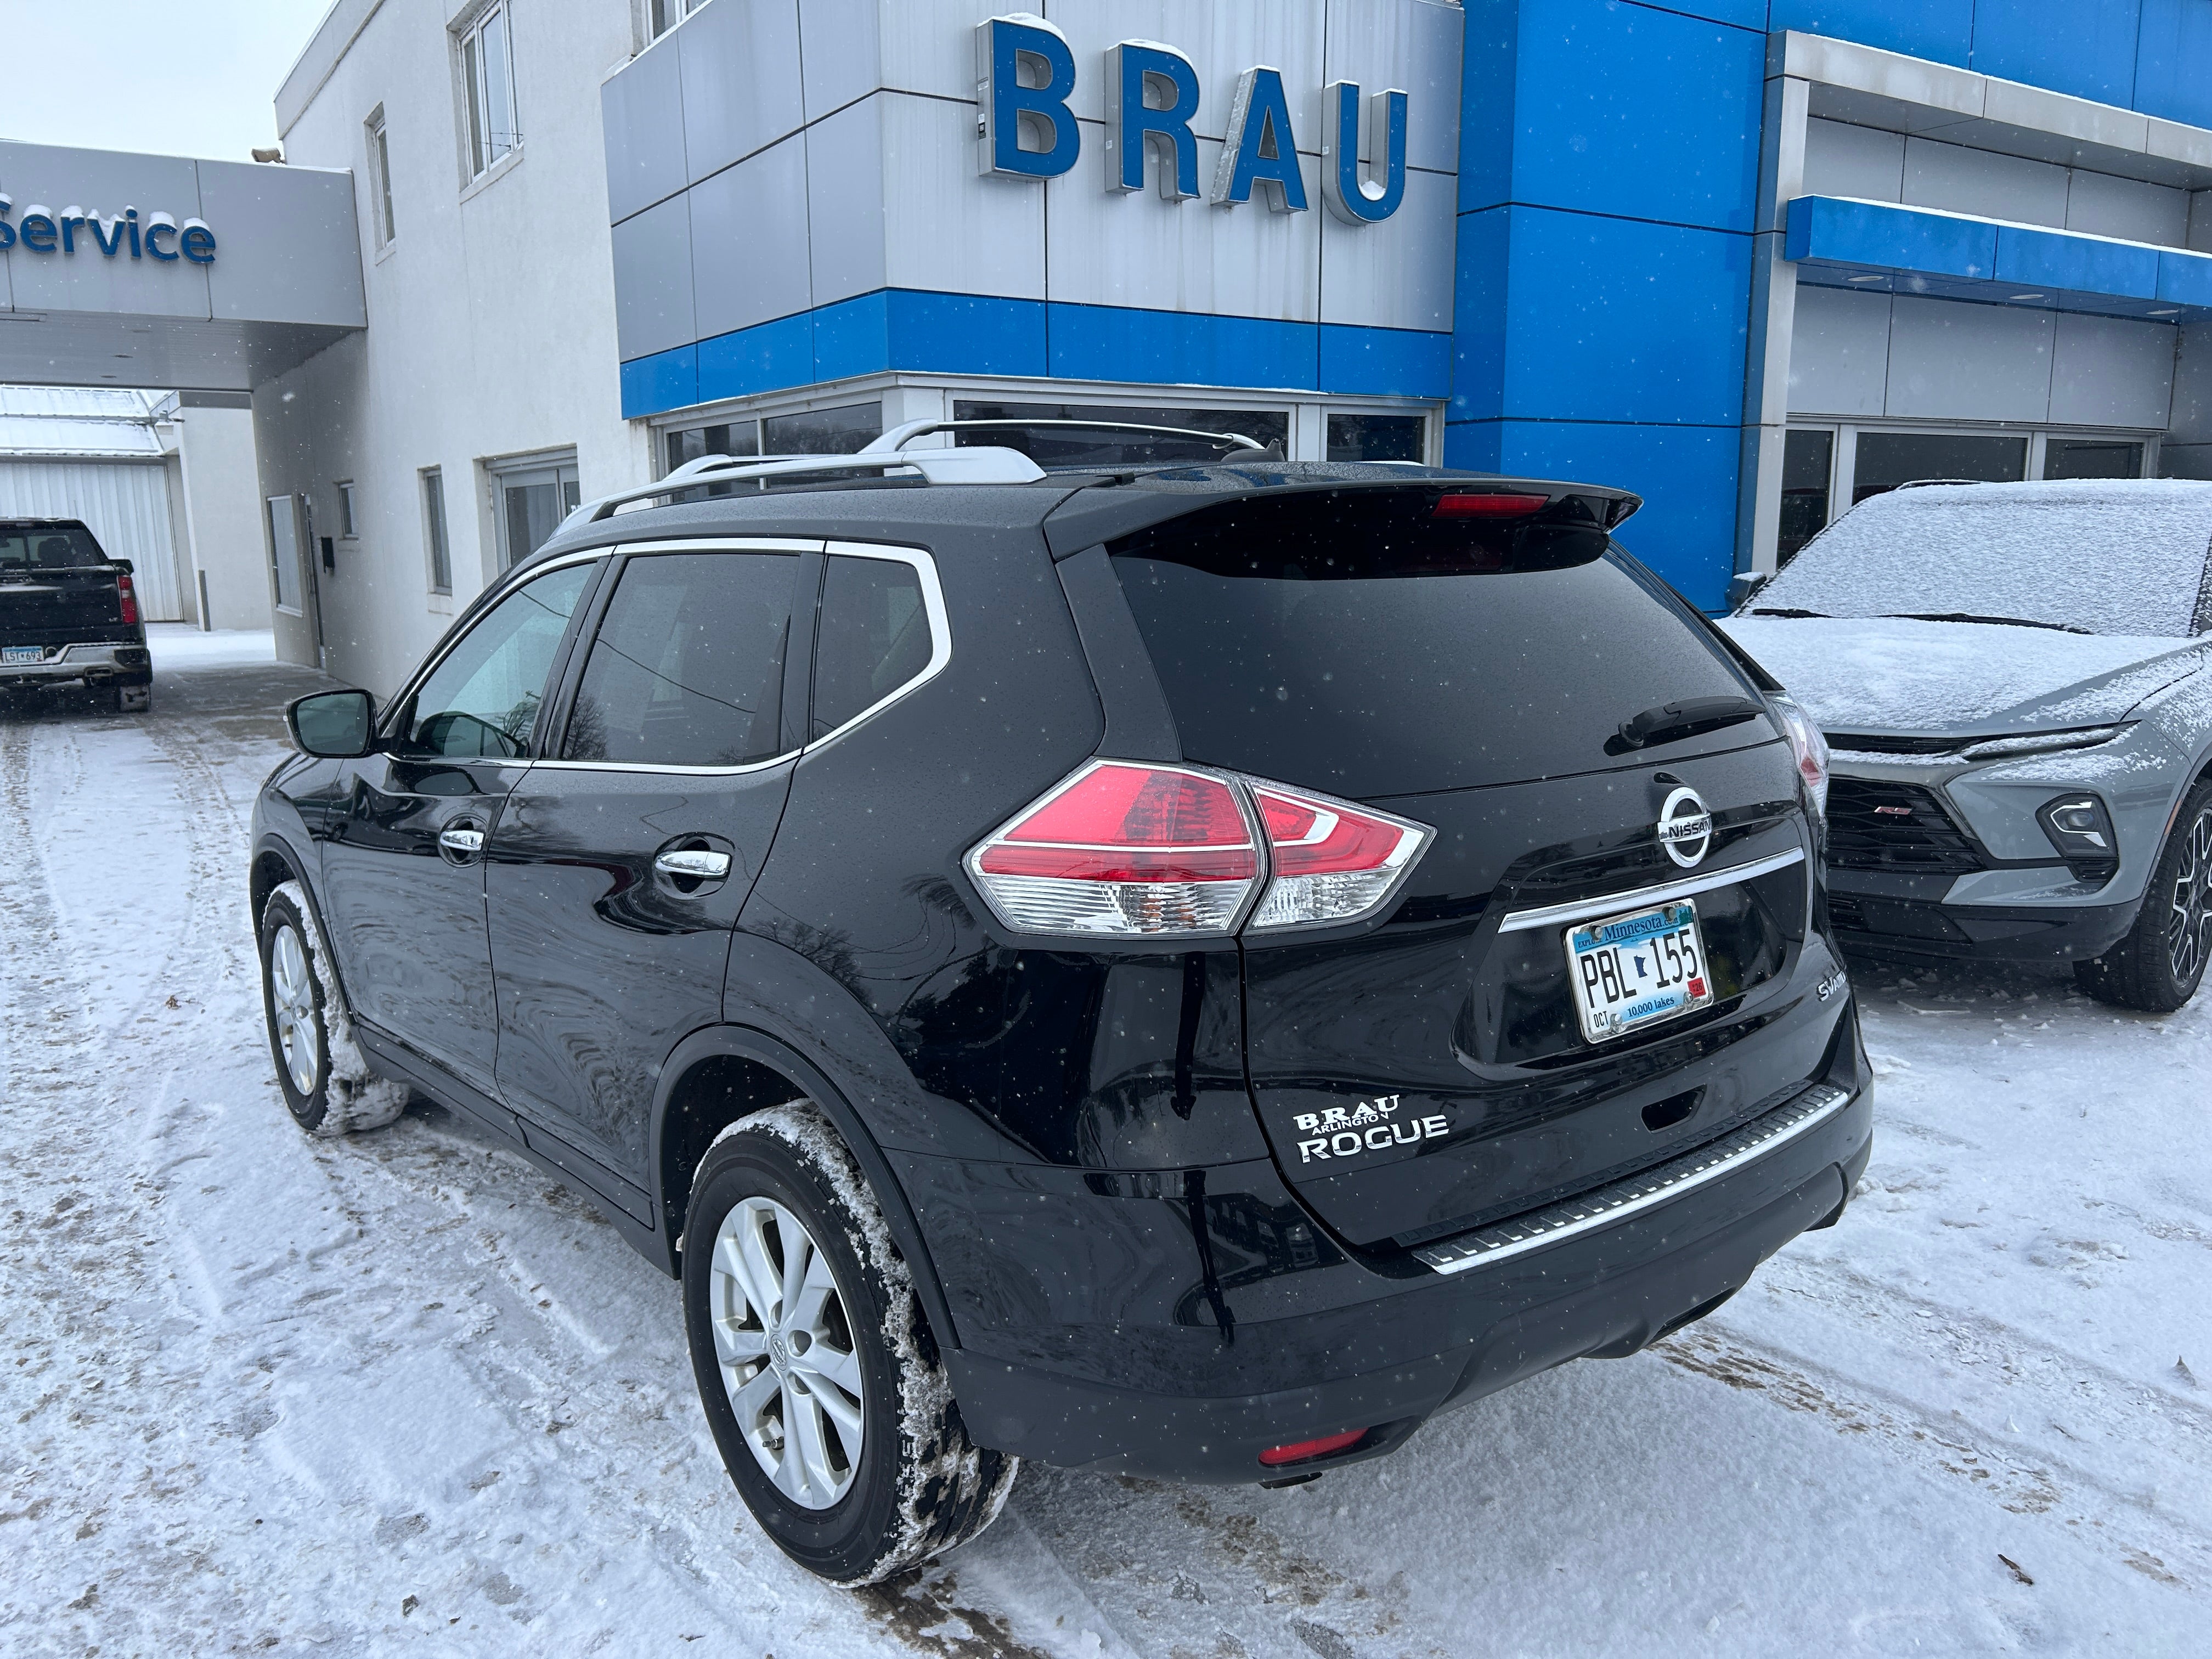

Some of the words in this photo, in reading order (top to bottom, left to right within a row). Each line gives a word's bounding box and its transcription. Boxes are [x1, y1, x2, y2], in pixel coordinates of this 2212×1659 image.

[979, 18, 1408, 225] BRAU
[1668, 818, 1712, 838] NISSAN
[1577, 937, 1603, 949] EXPLOE
[1580, 946, 1637, 1009] PBL
[1650, 928, 1698, 989] 155
[1593, 1011, 1609, 1028] OCT
[1627, 1001, 1653, 1018] 10,000
[1654, 997, 1674, 1009] lakes
[1293, 1094, 1400, 1131] BRAU
[1296, 1114, 1449, 1164] ROGUE
